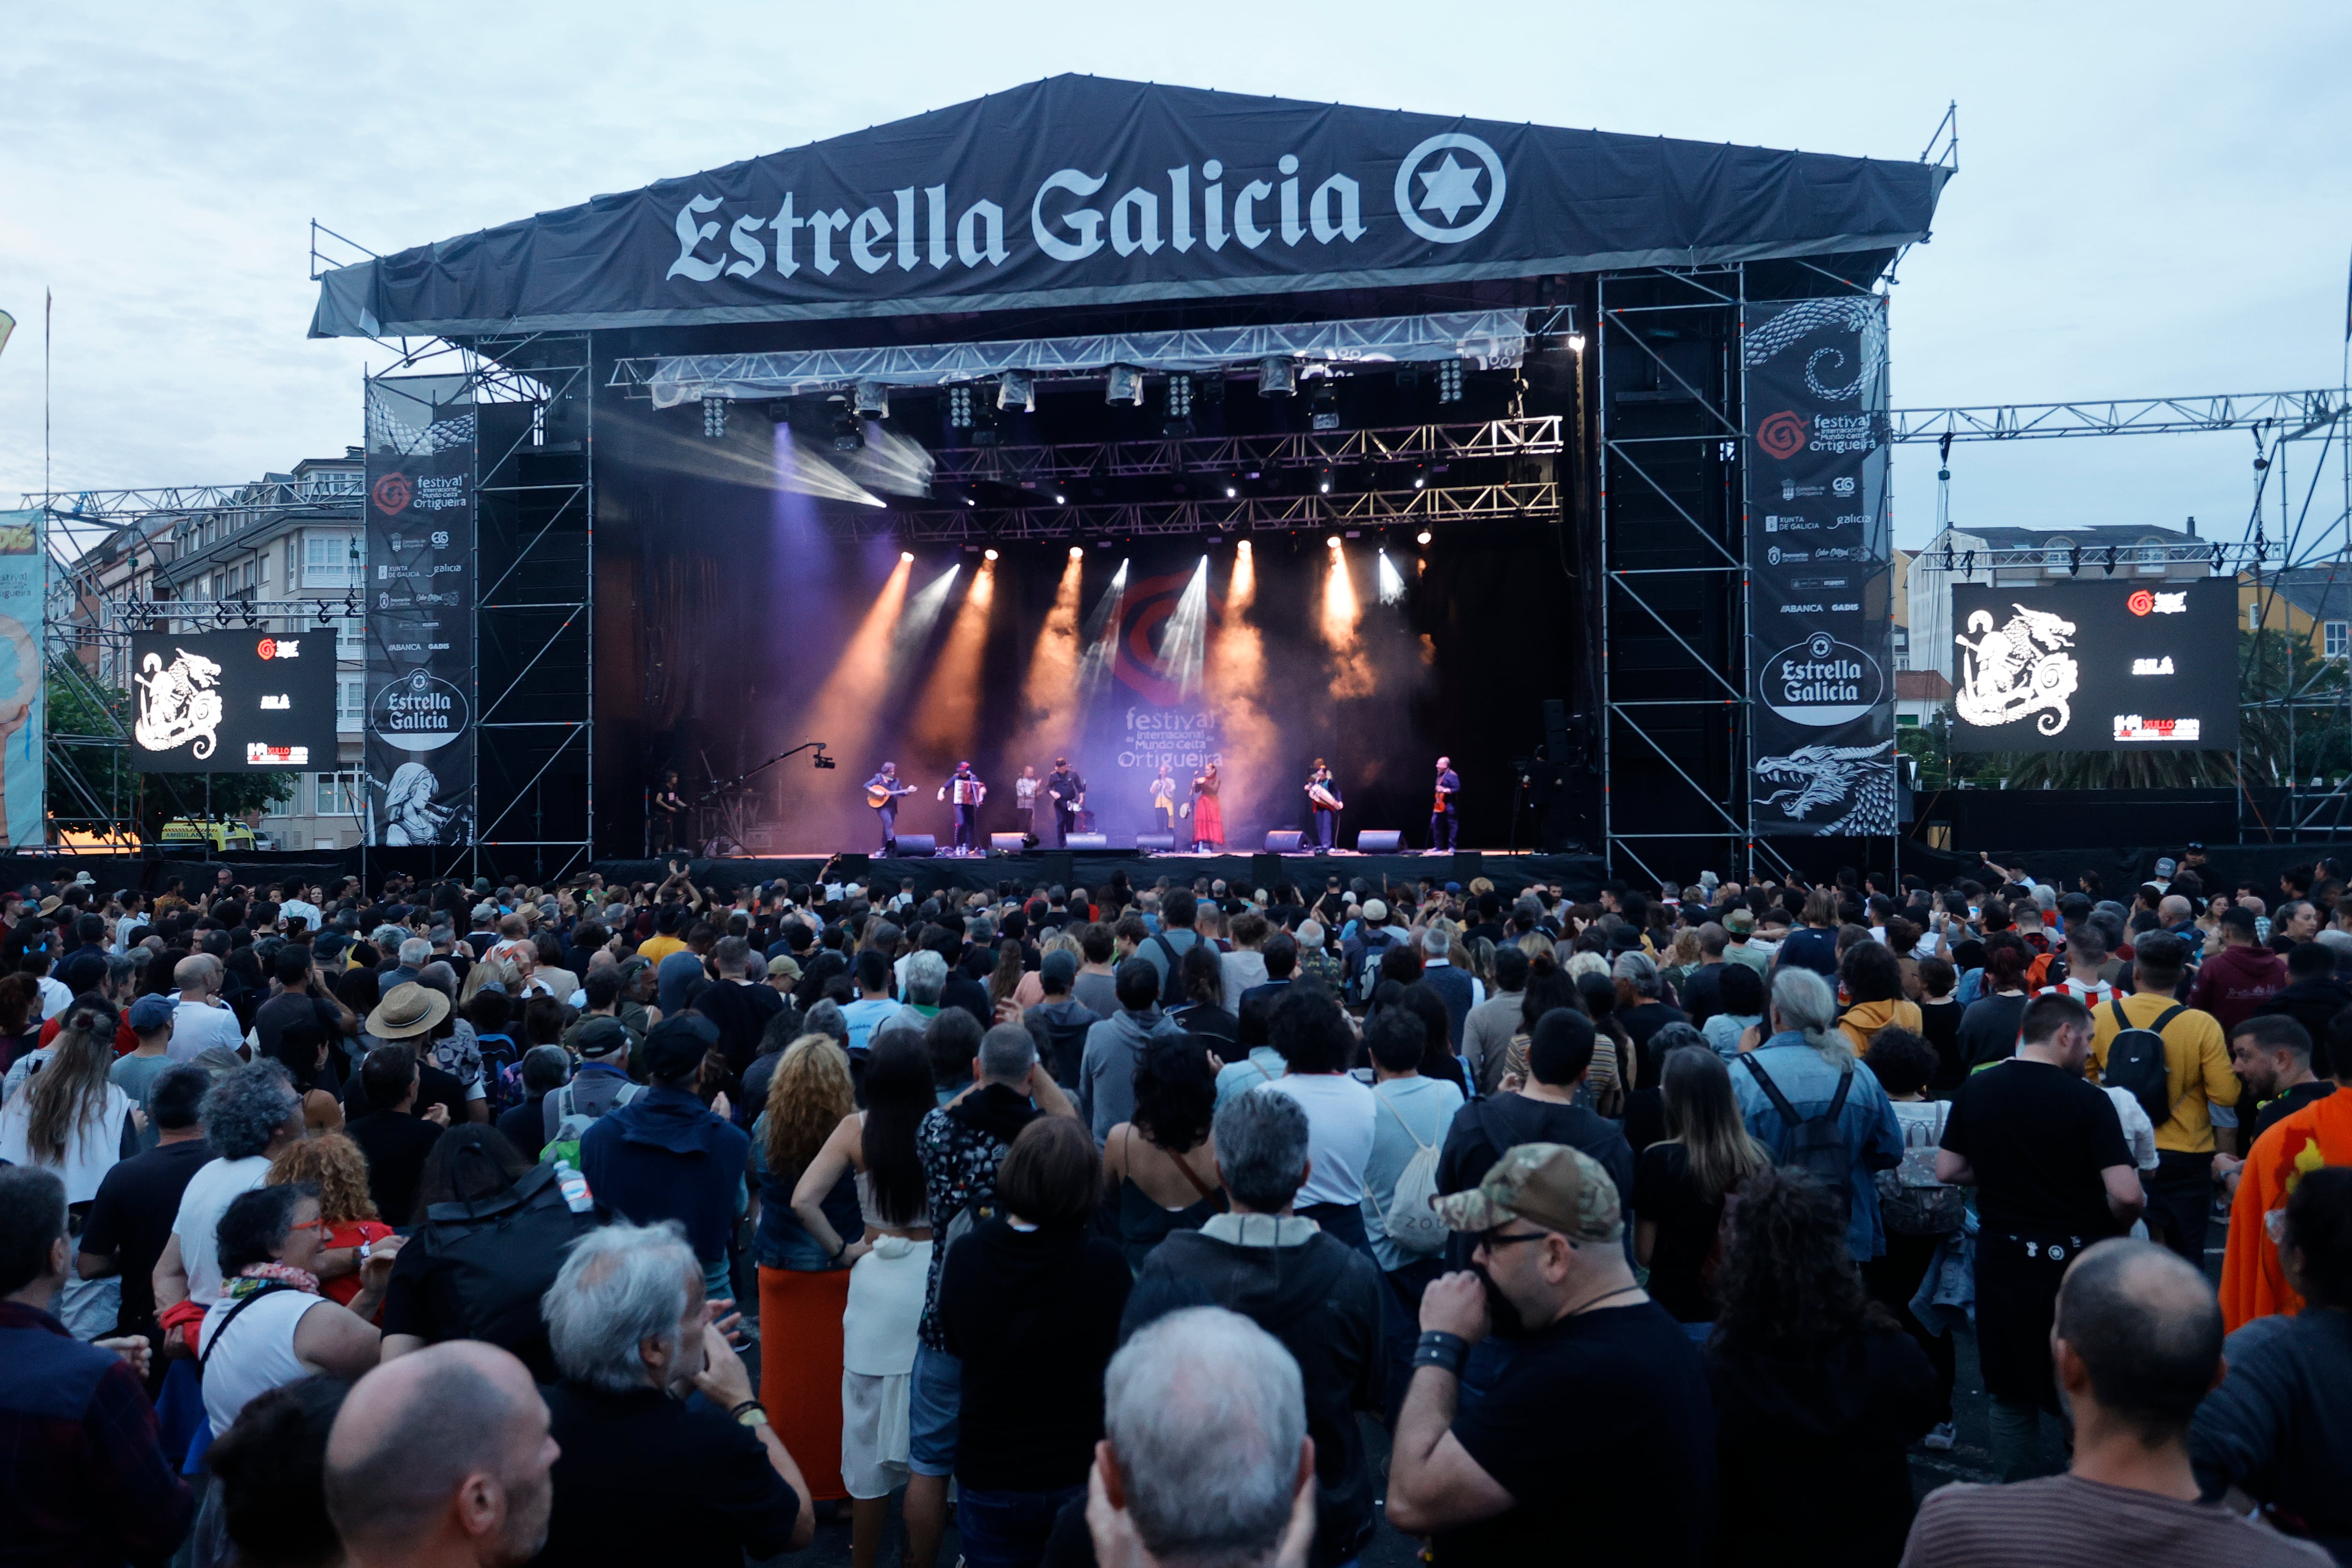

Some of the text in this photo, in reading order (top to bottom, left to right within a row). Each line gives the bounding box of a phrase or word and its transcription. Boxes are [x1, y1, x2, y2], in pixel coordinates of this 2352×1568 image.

[666, 154, 1368, 282] Estrella Galicia
[1814, 414, 1871, 429] festival
[1810, 438, 1876, 454] Ortigueira
[418, 475, 462, 488] festival
[413, 498, 466, 510] Ortigueira
[1827, 514, 1871, 529] galicia
[425, 564, 461, 577] galicia
[1785, 604, 1824, 613] ABANCA
[1780, 660, 1862, 680] Estrella
[1784, 680, 1859, 702] Galicia
[387, 692, 452, 710] Estrella
[389, 710, 449, 730] Galicia
[1126, 706, 1216, 730] festival
[2143, 719, 2175, 730] XULLO
[268, 747, 290, 755] XULLO
[1135, 740, 1174, 750] Mundo
[1176, 740, 1206, 749] Celta
[1118, 750, 1223, 772] Ortigueira
